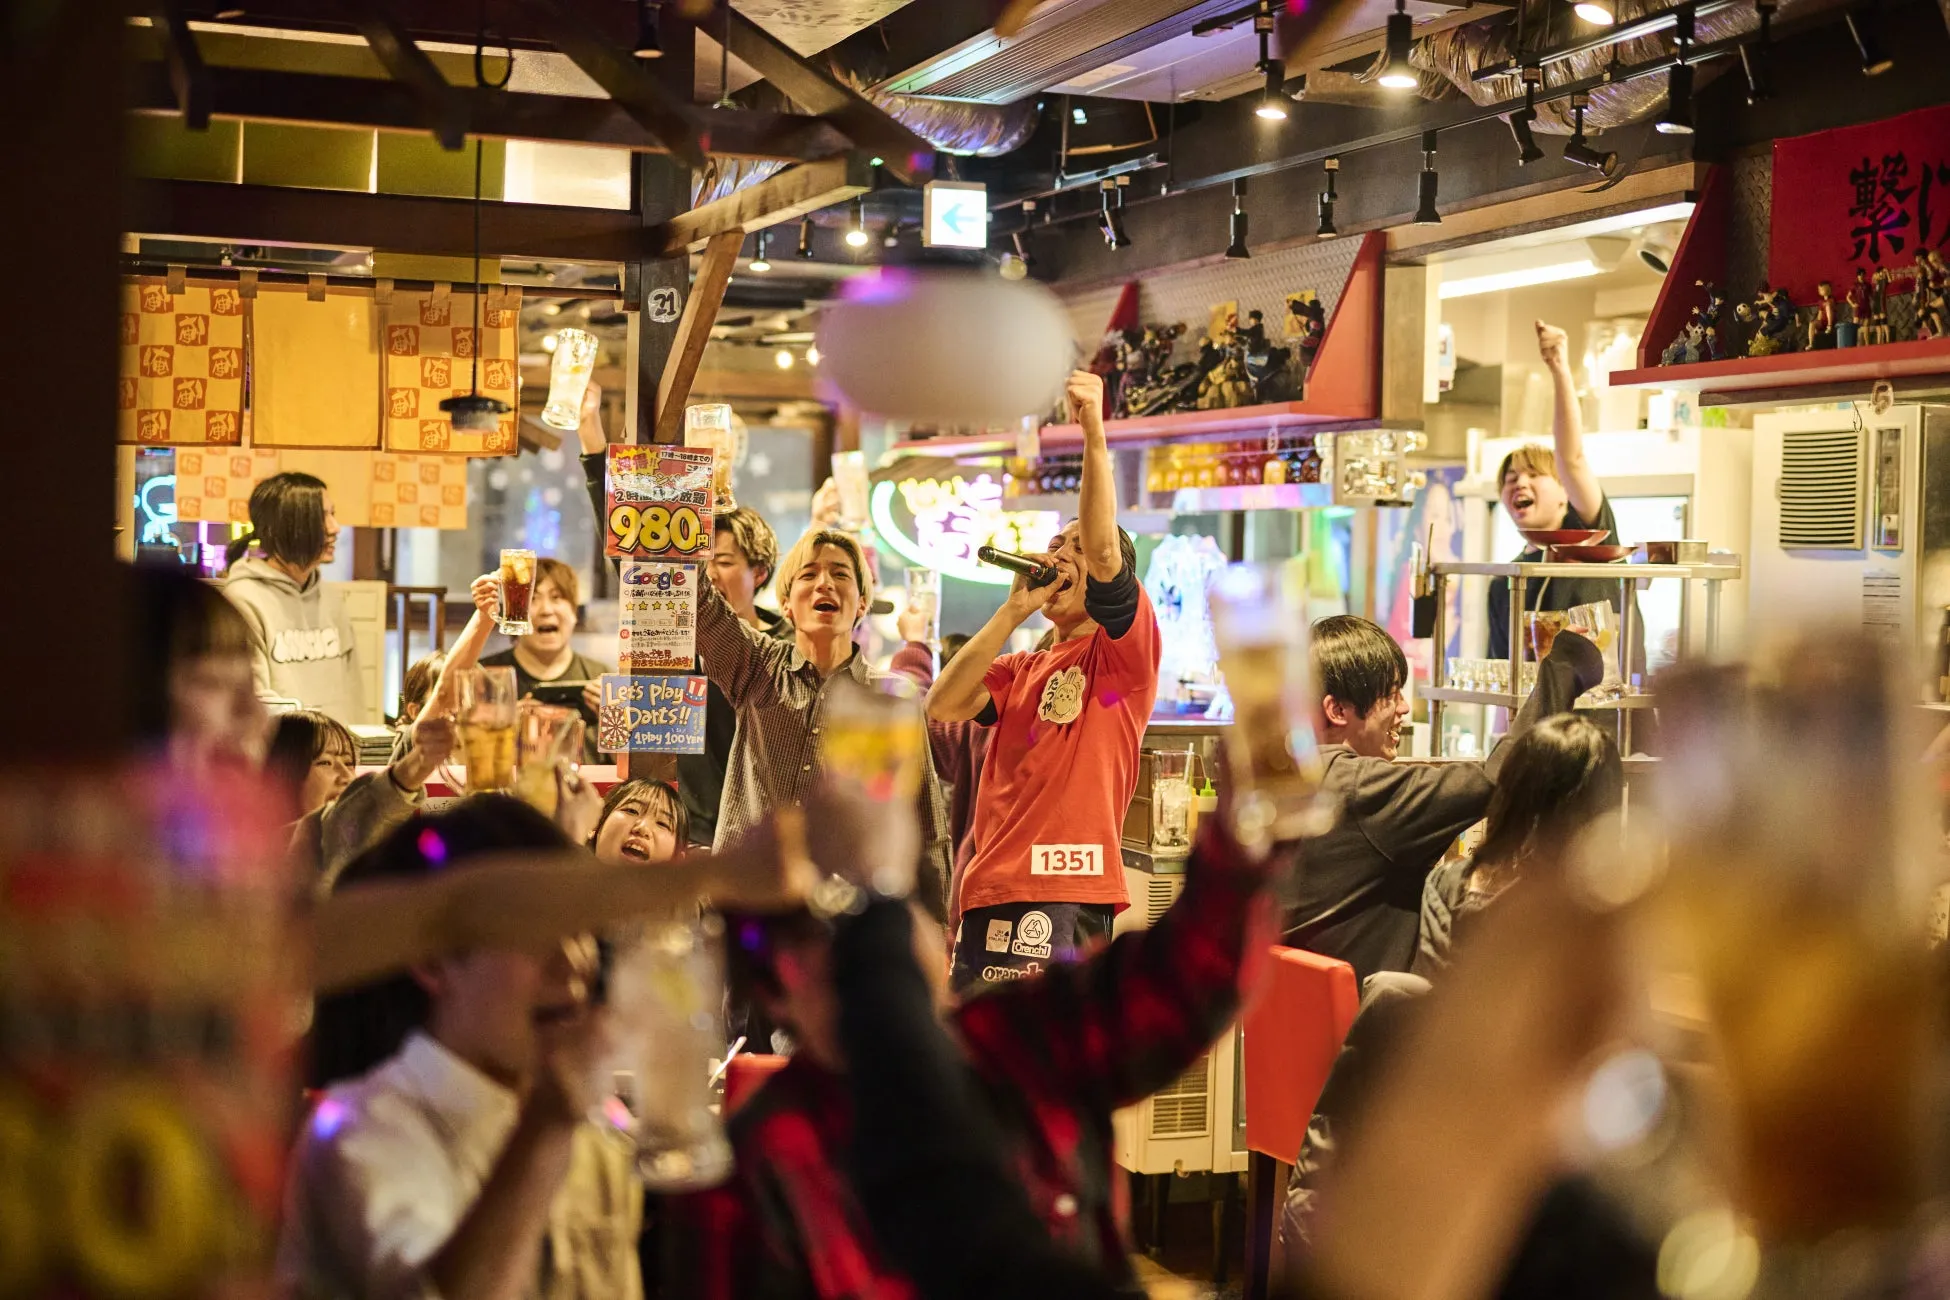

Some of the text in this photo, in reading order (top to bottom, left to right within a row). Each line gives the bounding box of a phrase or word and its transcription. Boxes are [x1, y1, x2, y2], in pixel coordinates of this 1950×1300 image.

[653, 291, 677, 317] 21
[609, 505, 711, 555] 980円
[622, 565, 686, 590] Google
[606, 680, 644, 706] Let's
[1042, 676, 1059, 716] たつや
[624, 705, 692, 732] Darts!!
[1040, 850, 1094, 872] 1351
[1015, 942, 1048, 956] Orenchi
